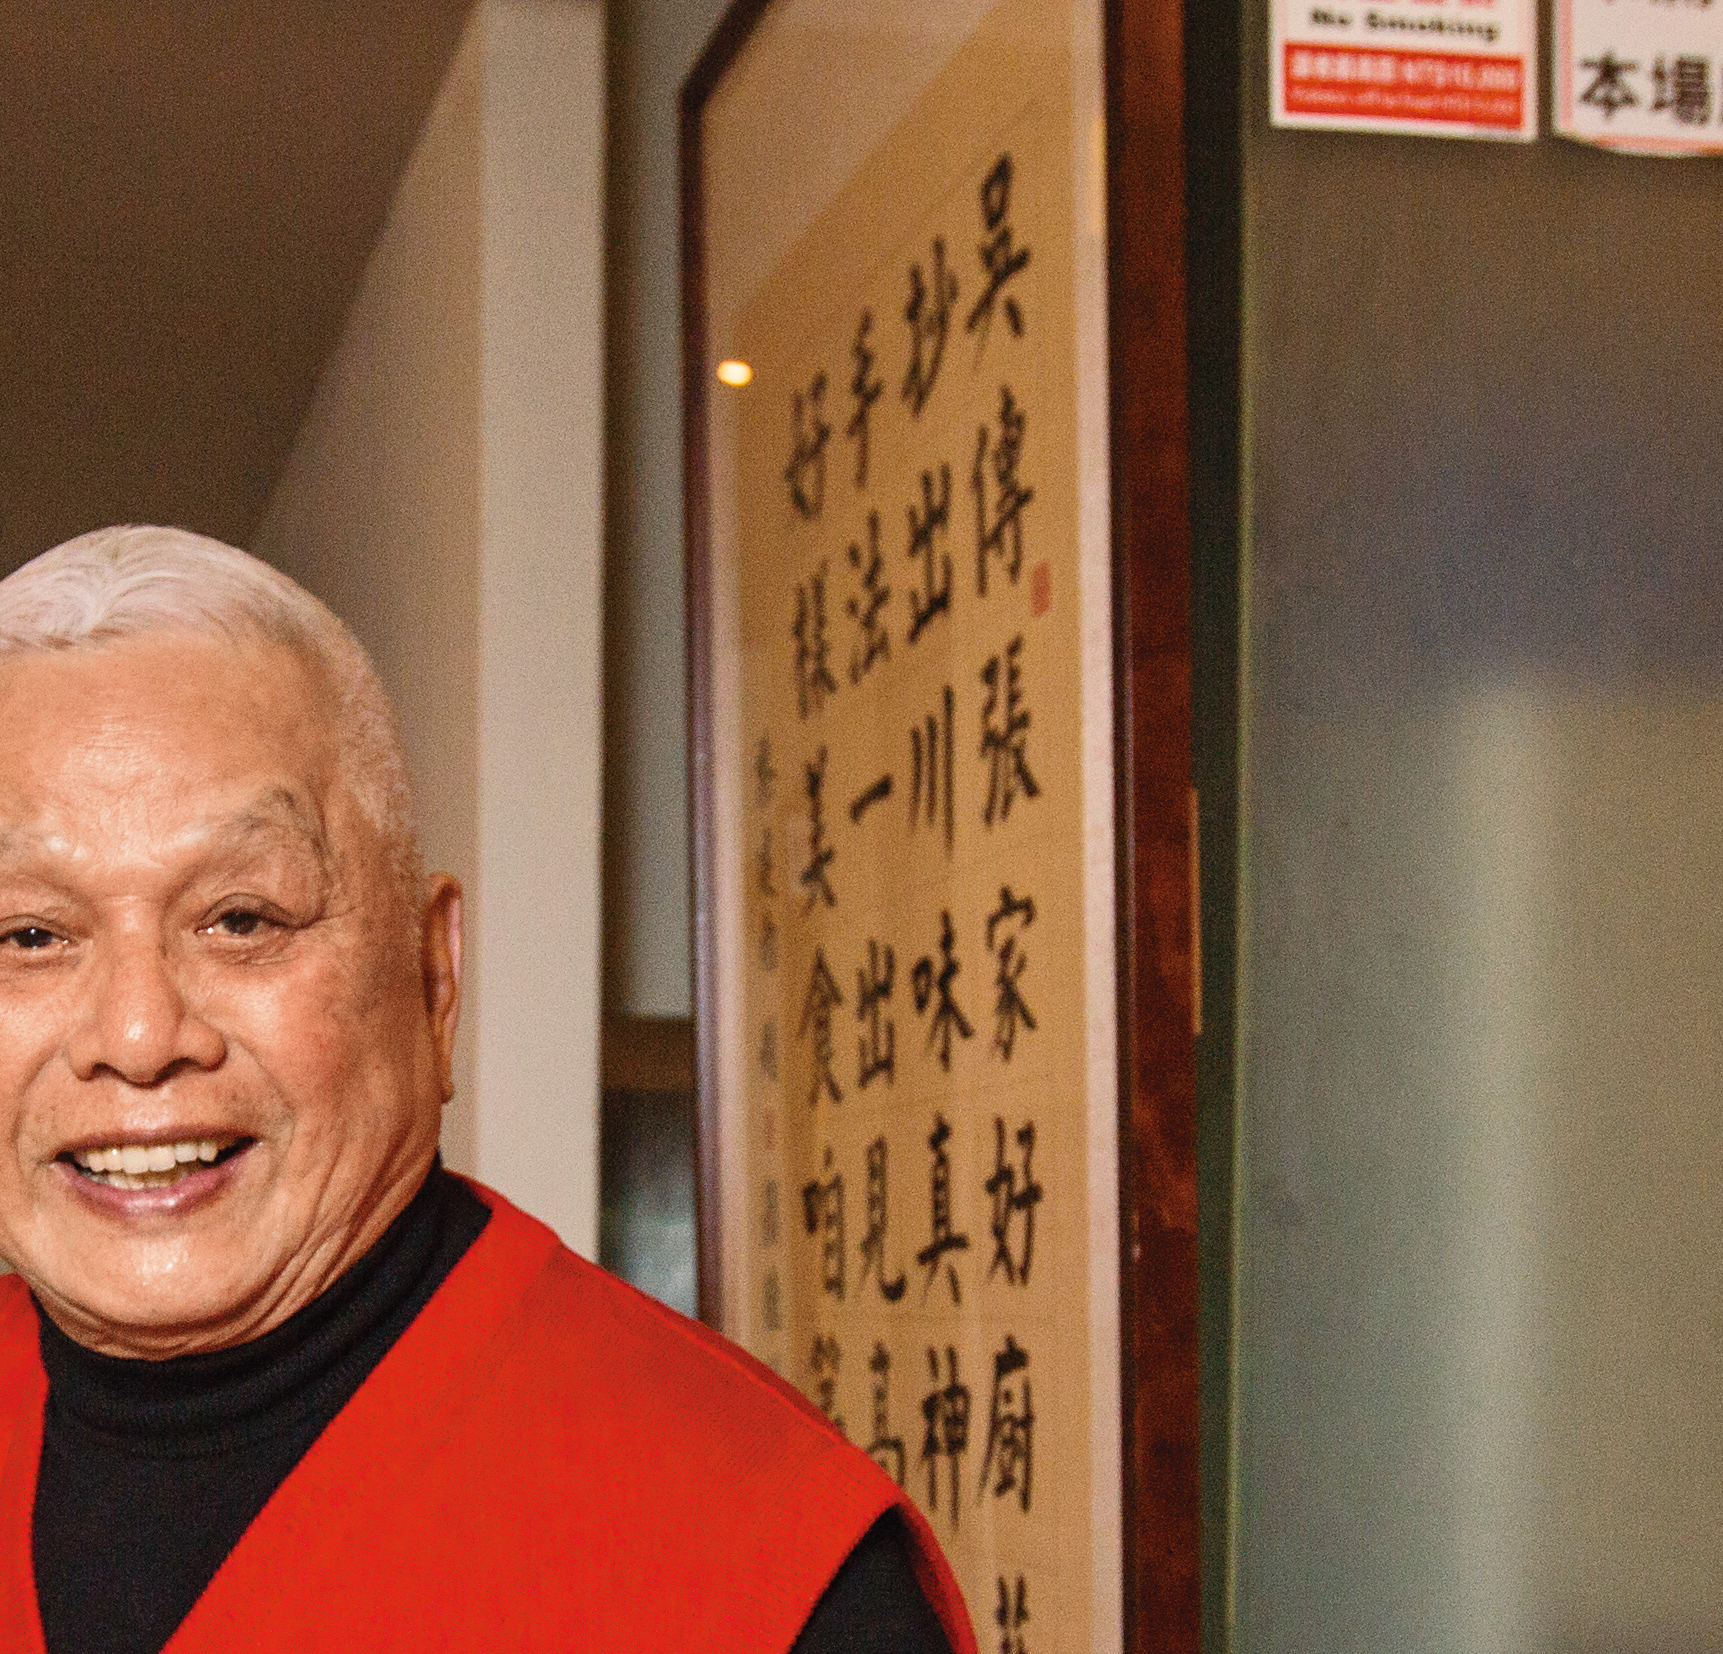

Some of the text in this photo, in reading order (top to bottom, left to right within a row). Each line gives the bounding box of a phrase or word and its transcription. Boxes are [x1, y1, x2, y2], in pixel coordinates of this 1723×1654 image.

[1311, 8, 1499, 43] No Smoking
[1579, 50, 1723, 126] 本場
